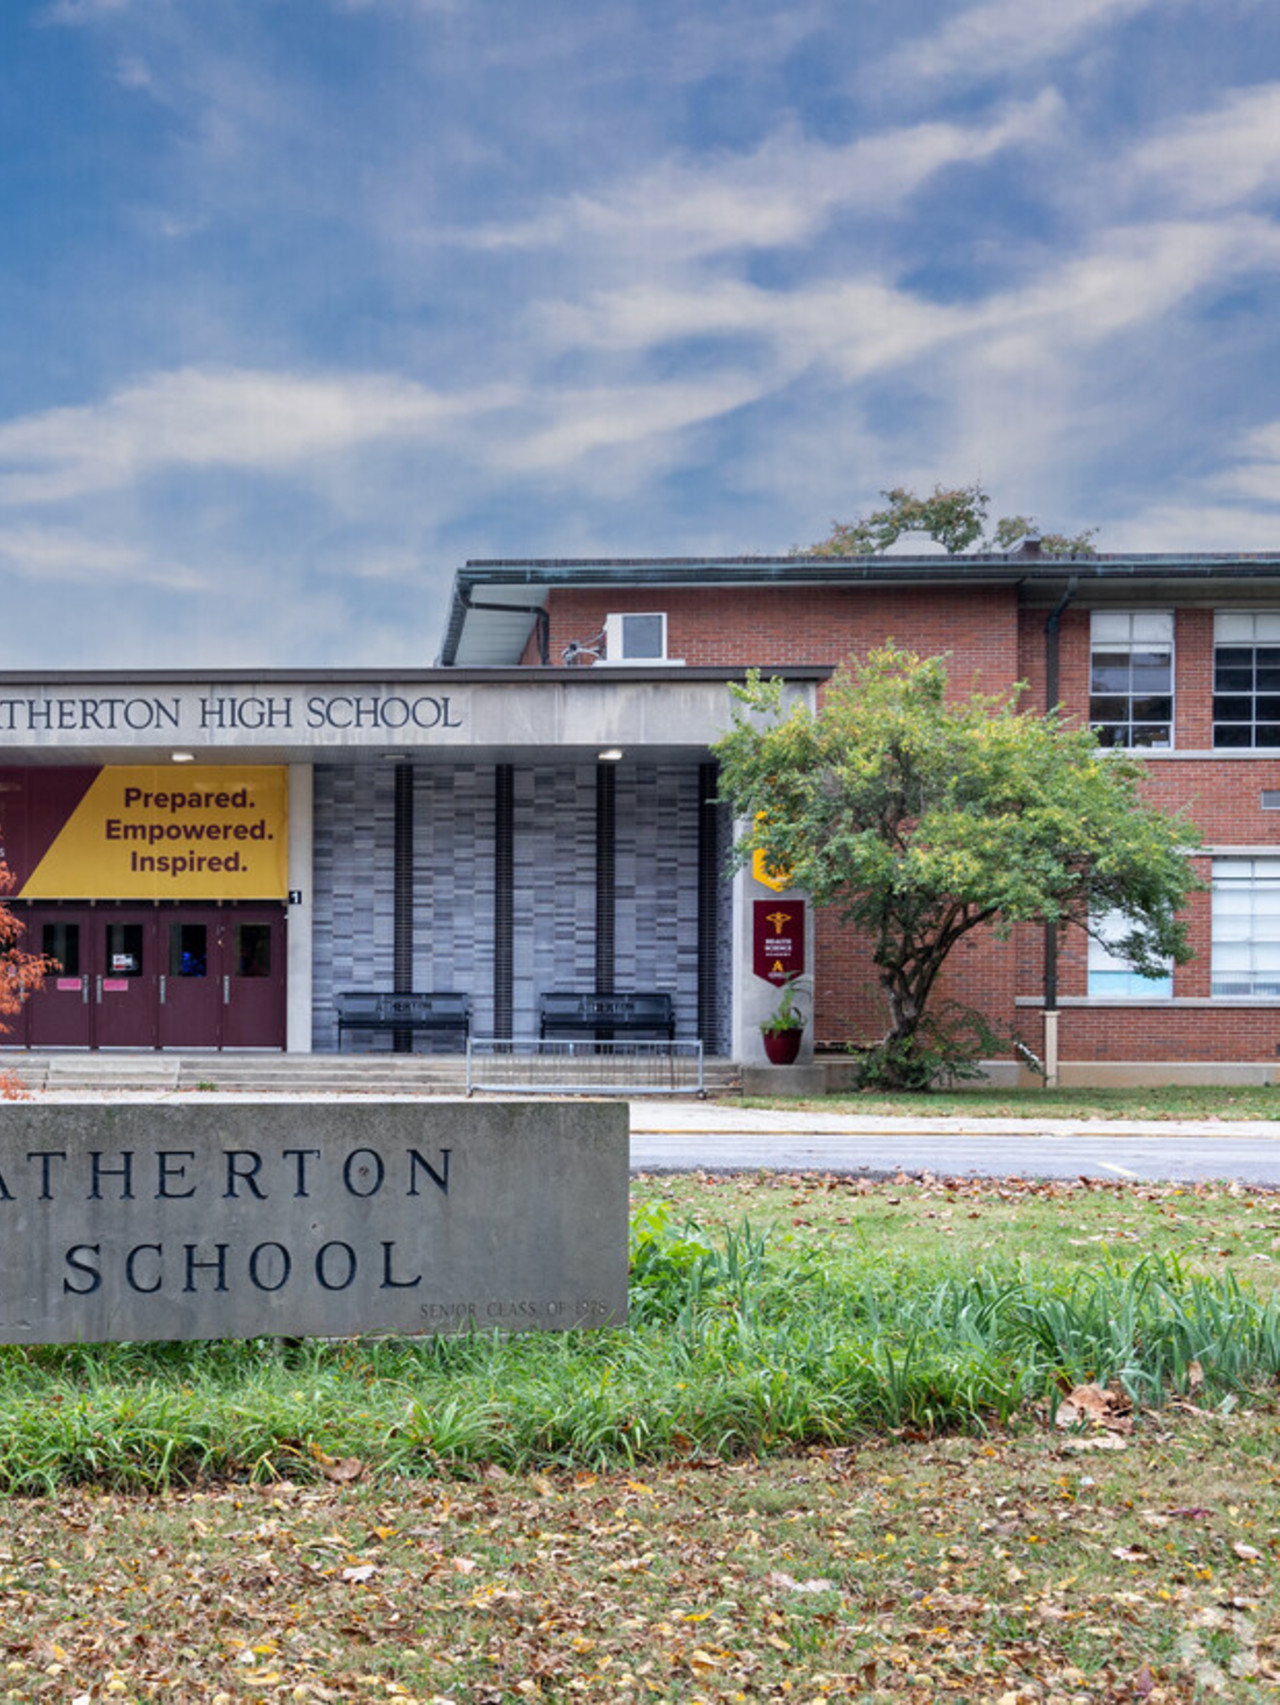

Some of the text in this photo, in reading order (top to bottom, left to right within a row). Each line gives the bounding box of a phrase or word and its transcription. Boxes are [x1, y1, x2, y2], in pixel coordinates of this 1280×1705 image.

[199, 697, 292, 729] HIGH
[307, 696, 462, 728] SCHOOL
[125, 787, 255, 812] Prepared.
[106, 819, 273, 845] Empowered.
[131, 849, 247, 876] Inspired.
[63, 1240, 423, 1296] SCHOOL
[420, 1303, 477, 1319] SENIOR
[486, 1301, 537, 1318] CLASS
[546, 1300, 568, 1316] OF
